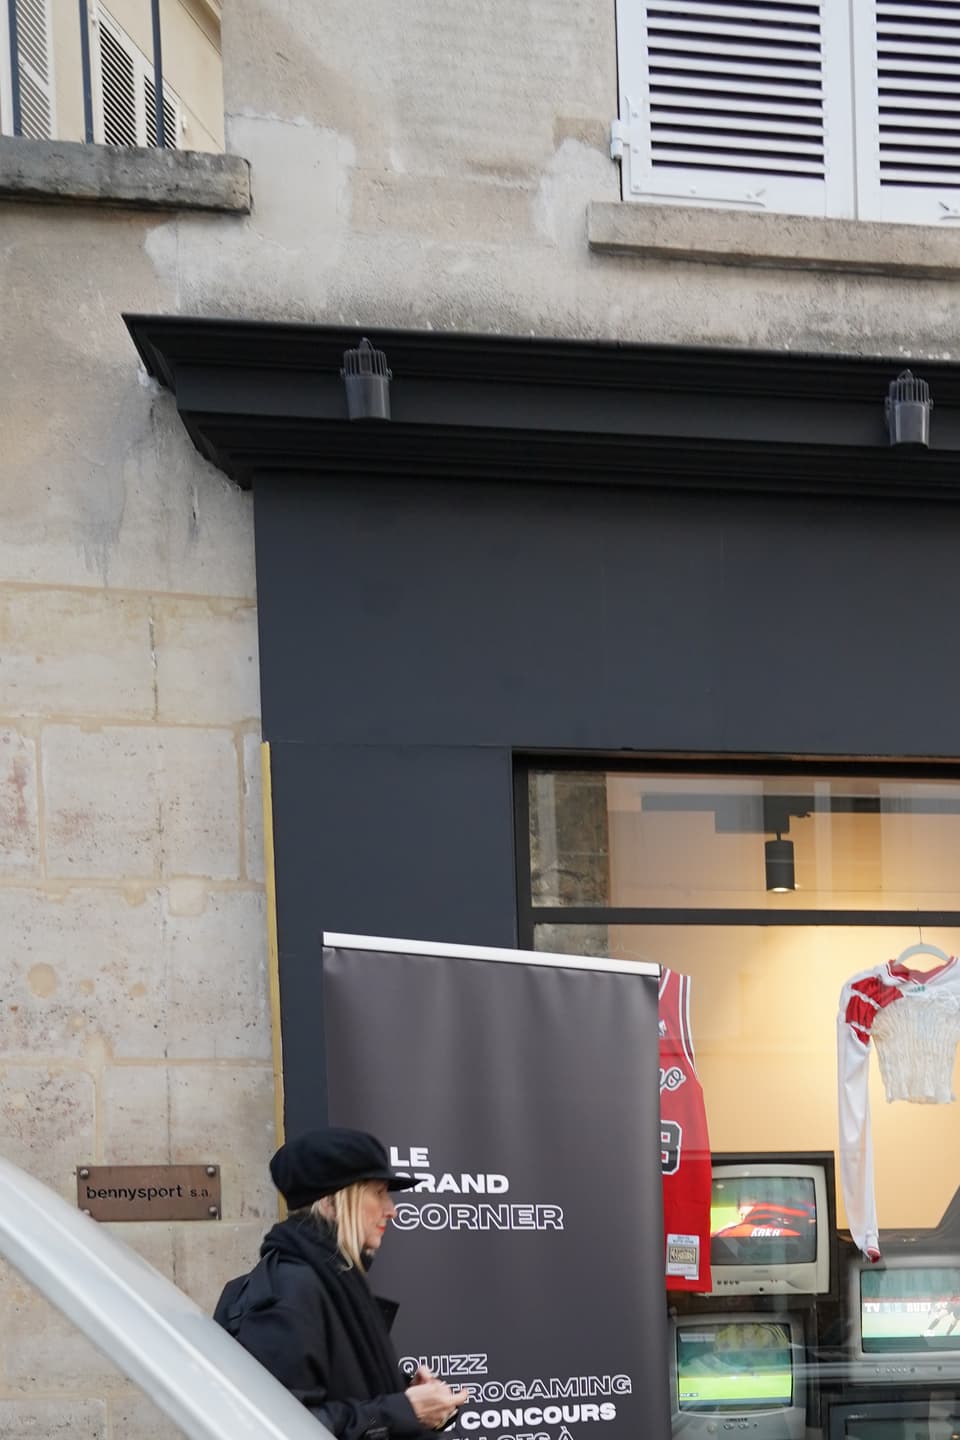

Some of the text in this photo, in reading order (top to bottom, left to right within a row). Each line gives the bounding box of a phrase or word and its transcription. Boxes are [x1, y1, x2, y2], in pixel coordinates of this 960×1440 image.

[390, 1146, 430, 1168] LE
[86, 1185, 182, 1201] bennysport
[392, 1203, 564, 1230] CORNER
[398, 1353, 488, 1379] QUIZZ
[448, 1373, 633, 1404] ROGAMING
[460, 1402, 617, 1431] CONCOURS
